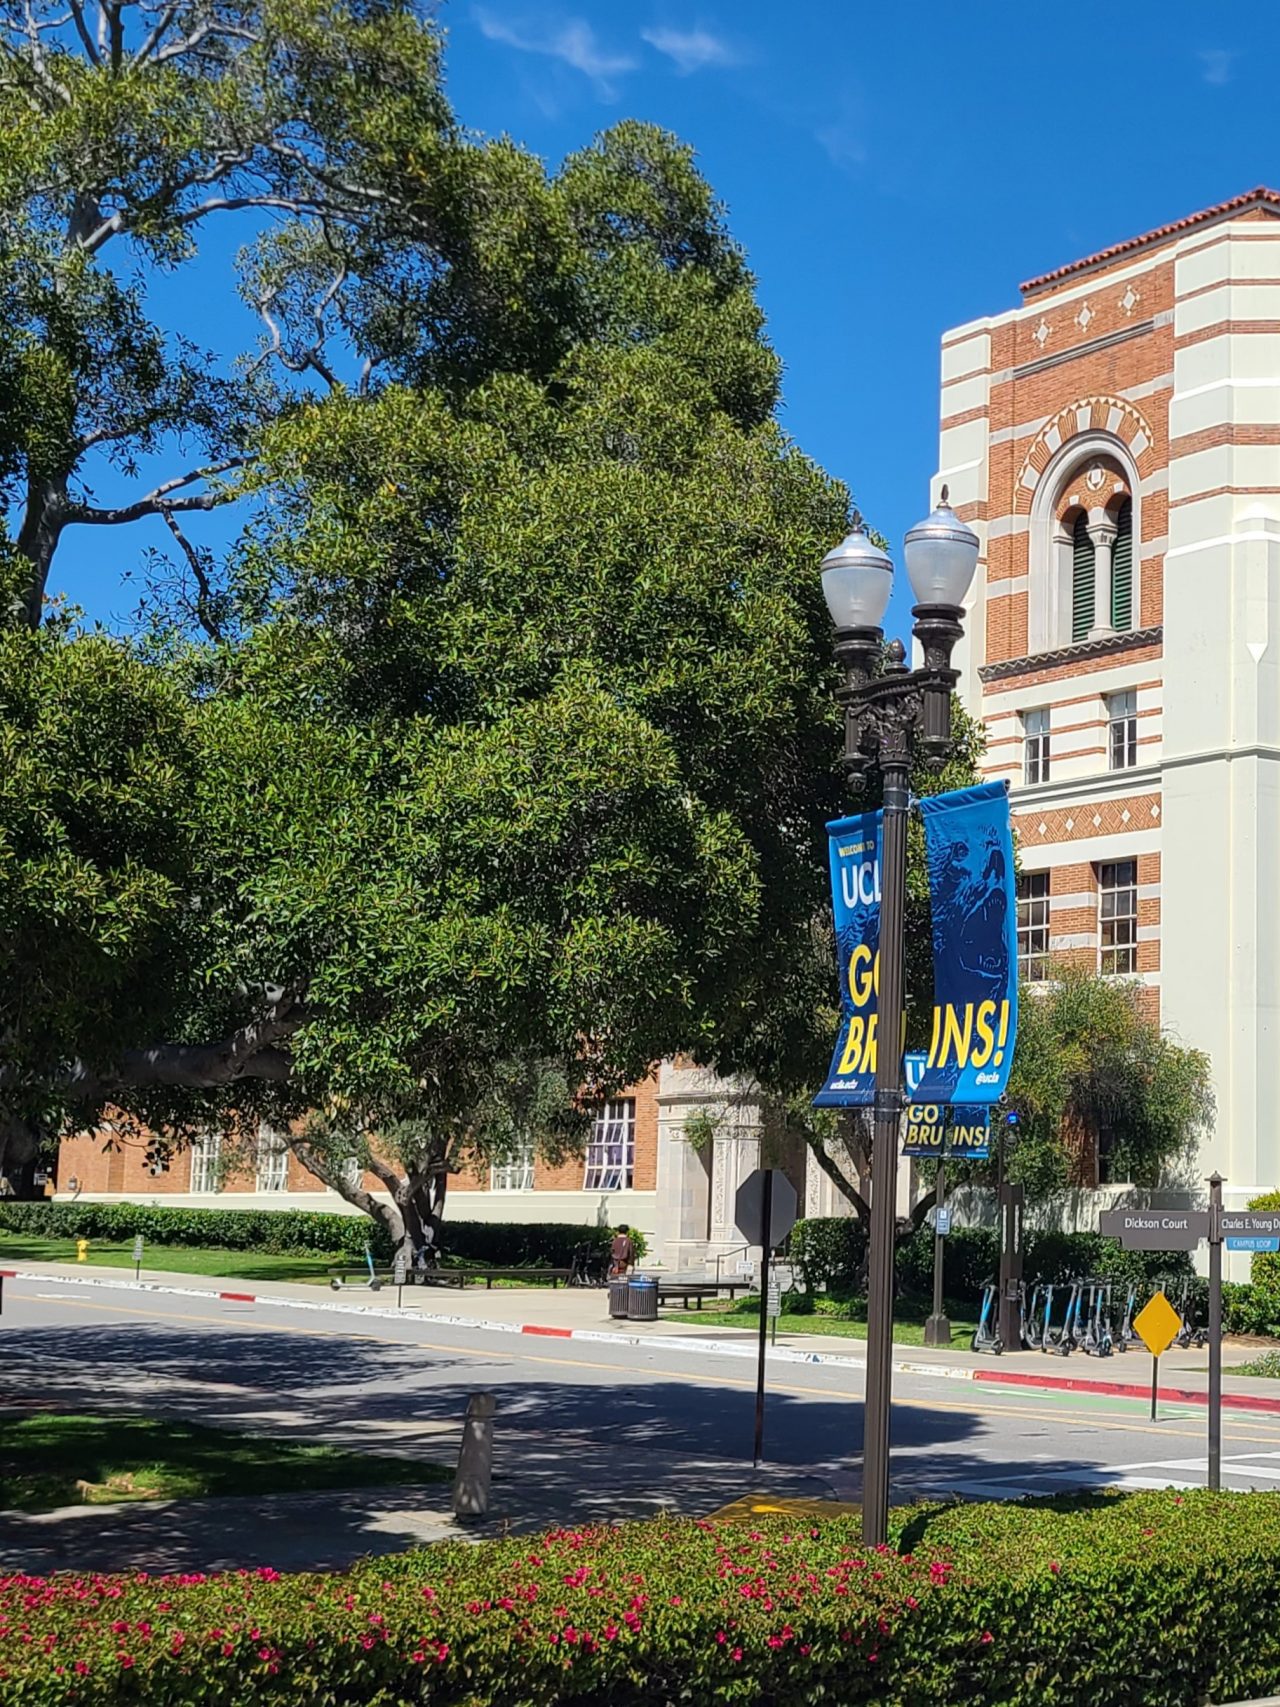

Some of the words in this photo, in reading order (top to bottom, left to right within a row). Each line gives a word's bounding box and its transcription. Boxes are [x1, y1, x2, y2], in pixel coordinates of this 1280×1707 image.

[841, 859, 882, 909] UCL
[926, 999, 1010, 1069] INS!
[908, 1105, 939, 1124] GO
[906, 1124, 944, 1146] BRU
[952, 1125, 990, 1147] INS!
[1124, 1217, 1160, 1229] Dickson
[1161, 1218, 1188, 1229] Court
[1221, 1218, 1244, 1229] Charles
[1245, 1219, 1252, 1229] E.
[1252, 1218, 1272, 1232] Young
[1232, 1240, 1255, 1249] CAMPUS
[1256, 1240, 1272, 1249] LOOP
